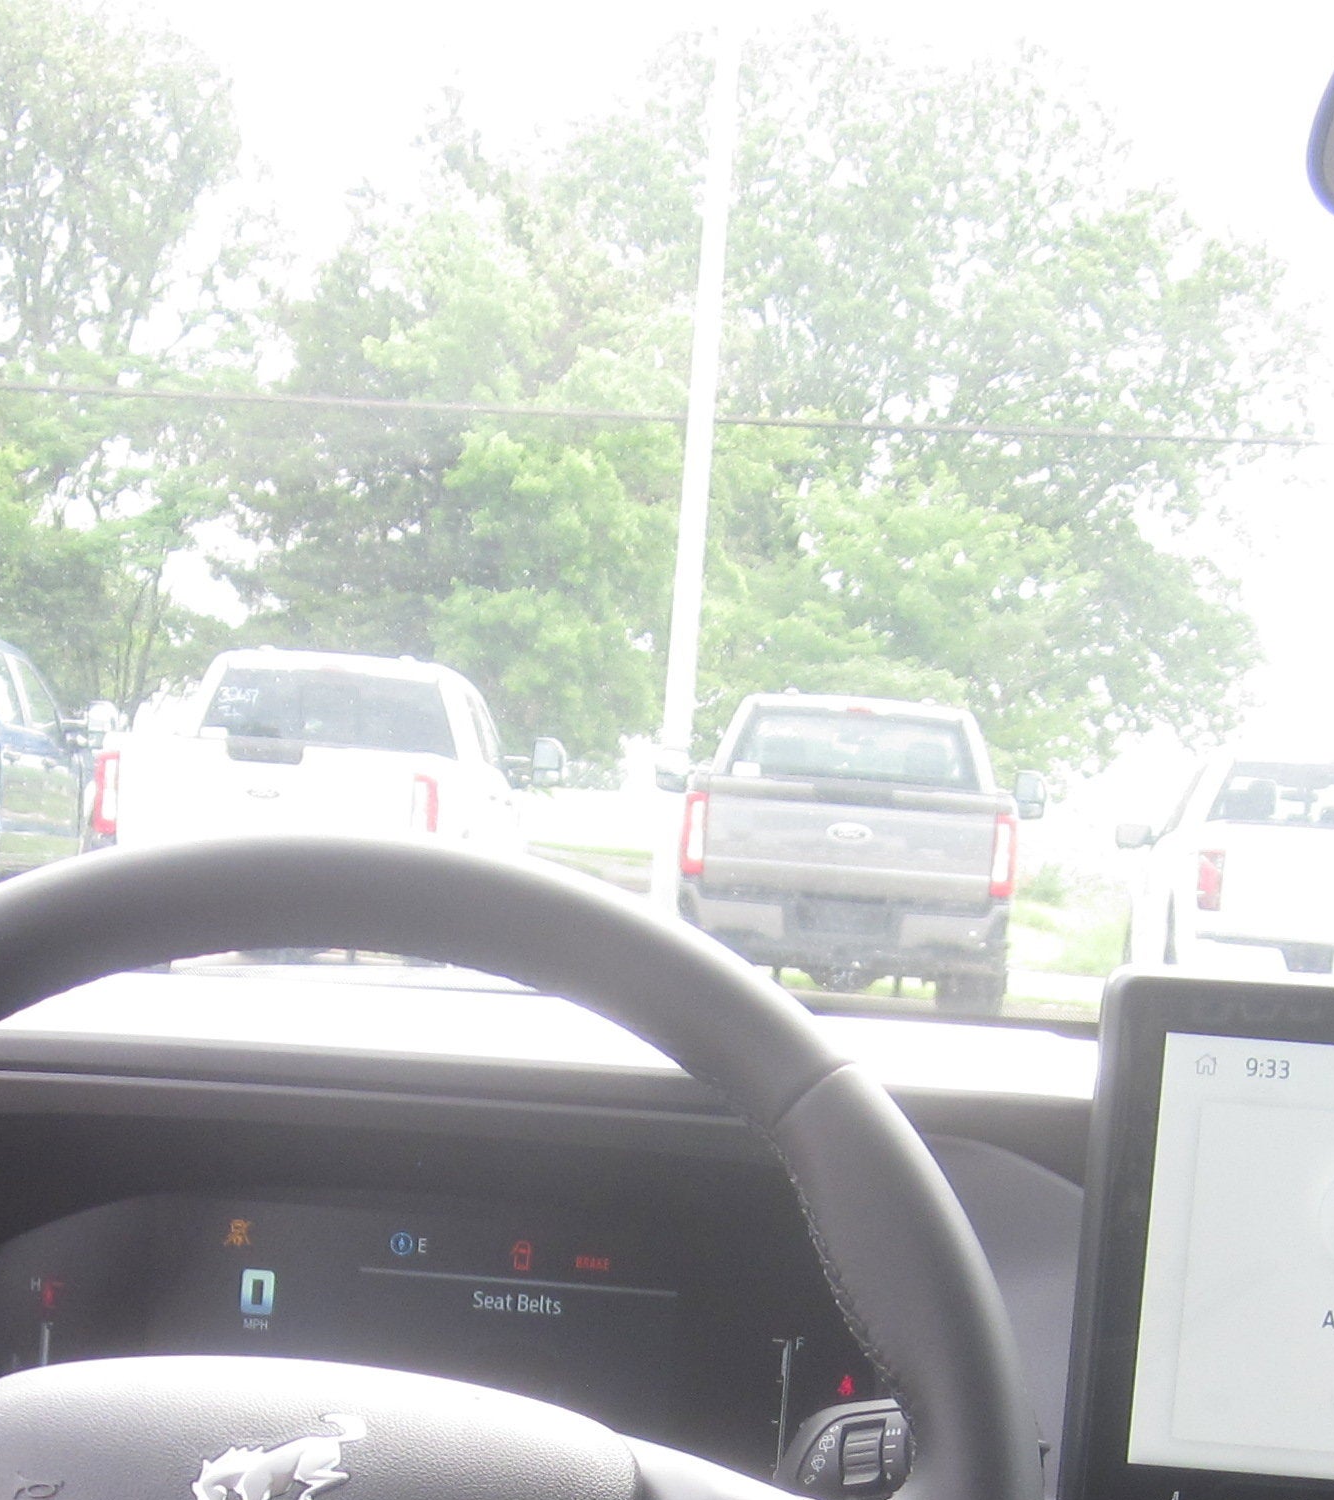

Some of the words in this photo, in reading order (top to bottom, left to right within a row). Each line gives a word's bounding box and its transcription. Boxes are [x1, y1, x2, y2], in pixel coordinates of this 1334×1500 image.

[1245, 1057, 1290, 1080] 9:33
[418, 1237, 428, 1254] E
[240, 1268, 275, 1315] 0
[472, 1290, 512, 1312] Seat
[517, 1292, 562, 1315] Belts
[796, 1336, 805, 1350] F
